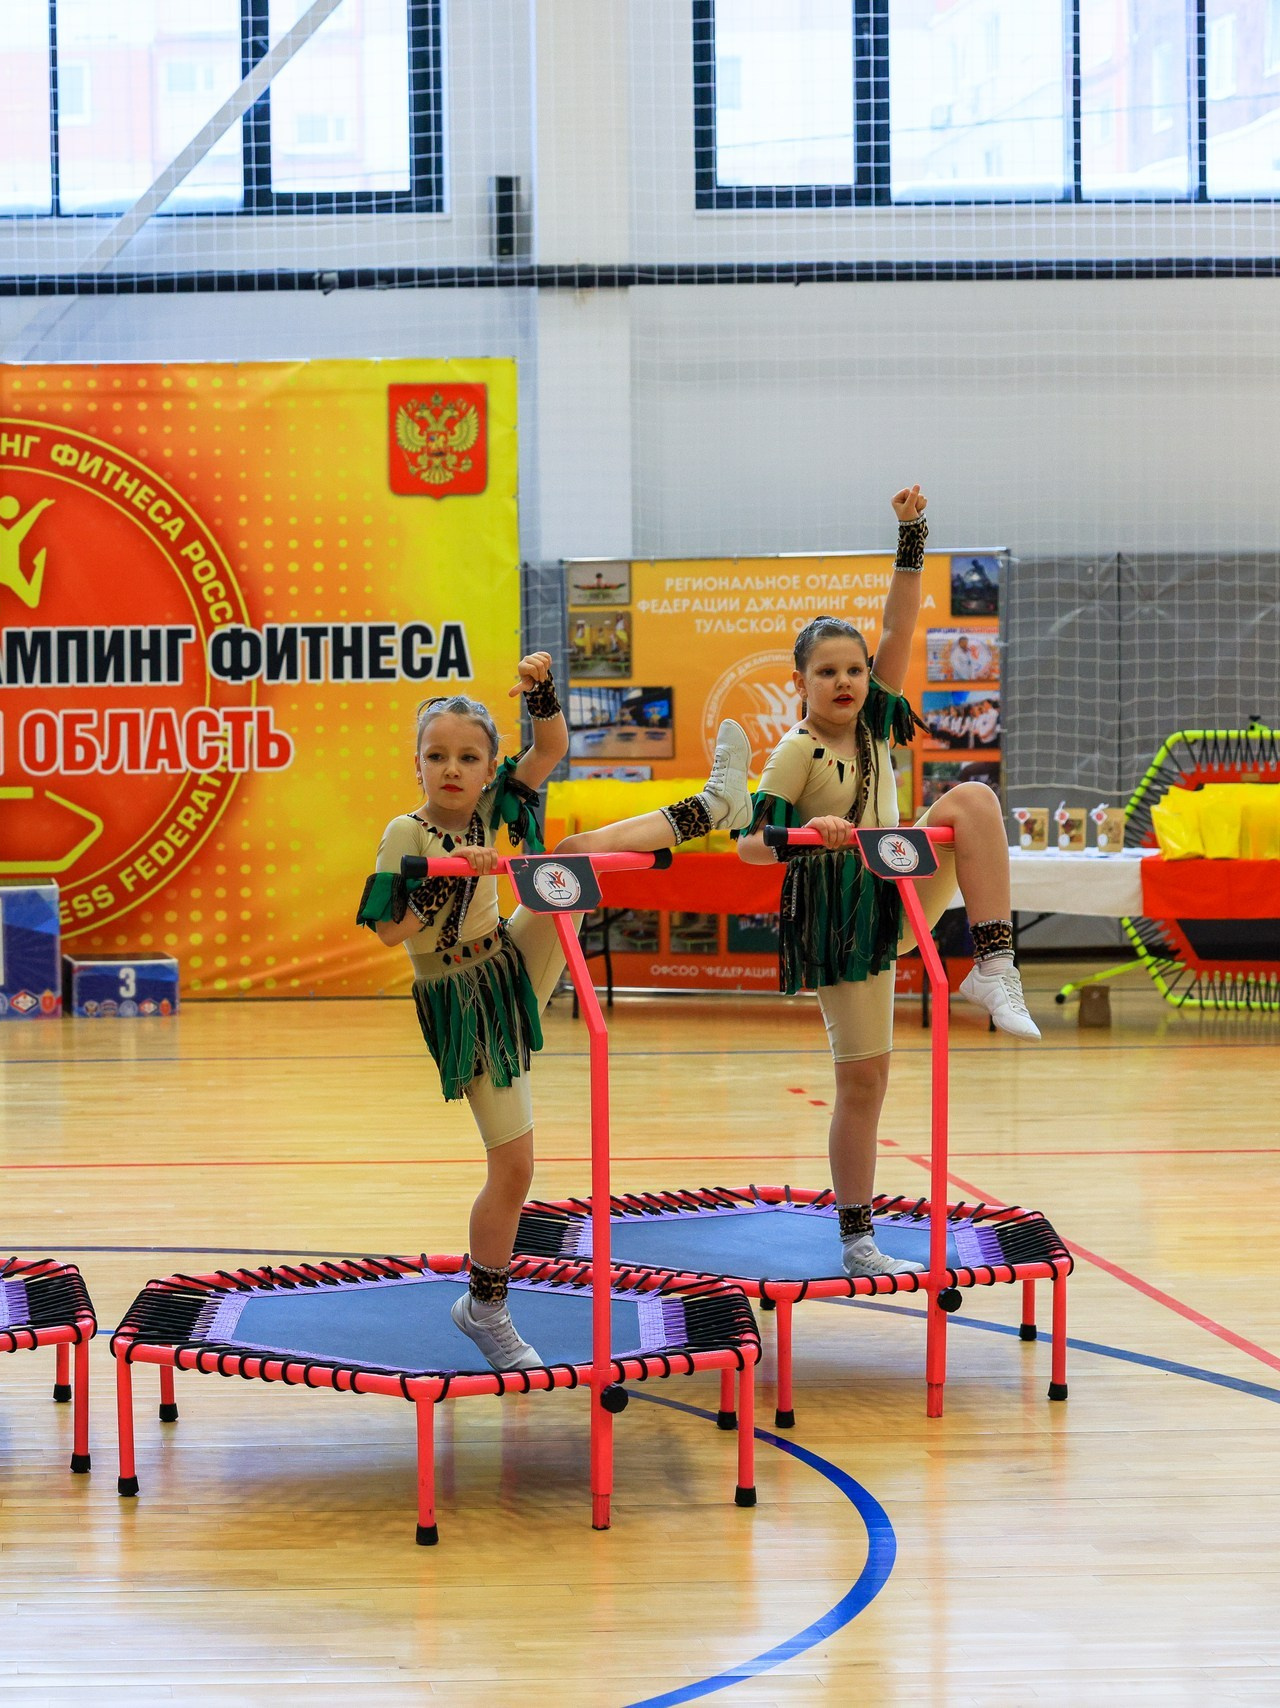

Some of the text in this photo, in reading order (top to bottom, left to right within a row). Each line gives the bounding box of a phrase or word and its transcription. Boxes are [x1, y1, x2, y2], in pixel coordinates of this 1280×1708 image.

[50, 443, 186, 542] ФИТНЕСА
[180, 540, 237, 630] РОСС
[637, 594, 936, 614] ФЕДЕРАЦИИ ДЖАМПИНГ ФИТА
[665, 574, 893, 592] РЕГИОНАЛЬНОЕ ОТДЕЛЕН
[695, 614, 876, 633] ТУЛЬСКОЙ ОСТИ
[209, 620, 474, 685] ФИТНЕСА
[19, 706, 294, 777] ОБЛАСТЬ
[118, 725, 230, 892] FEDERAT
[119, 967, 136, 998] 3
